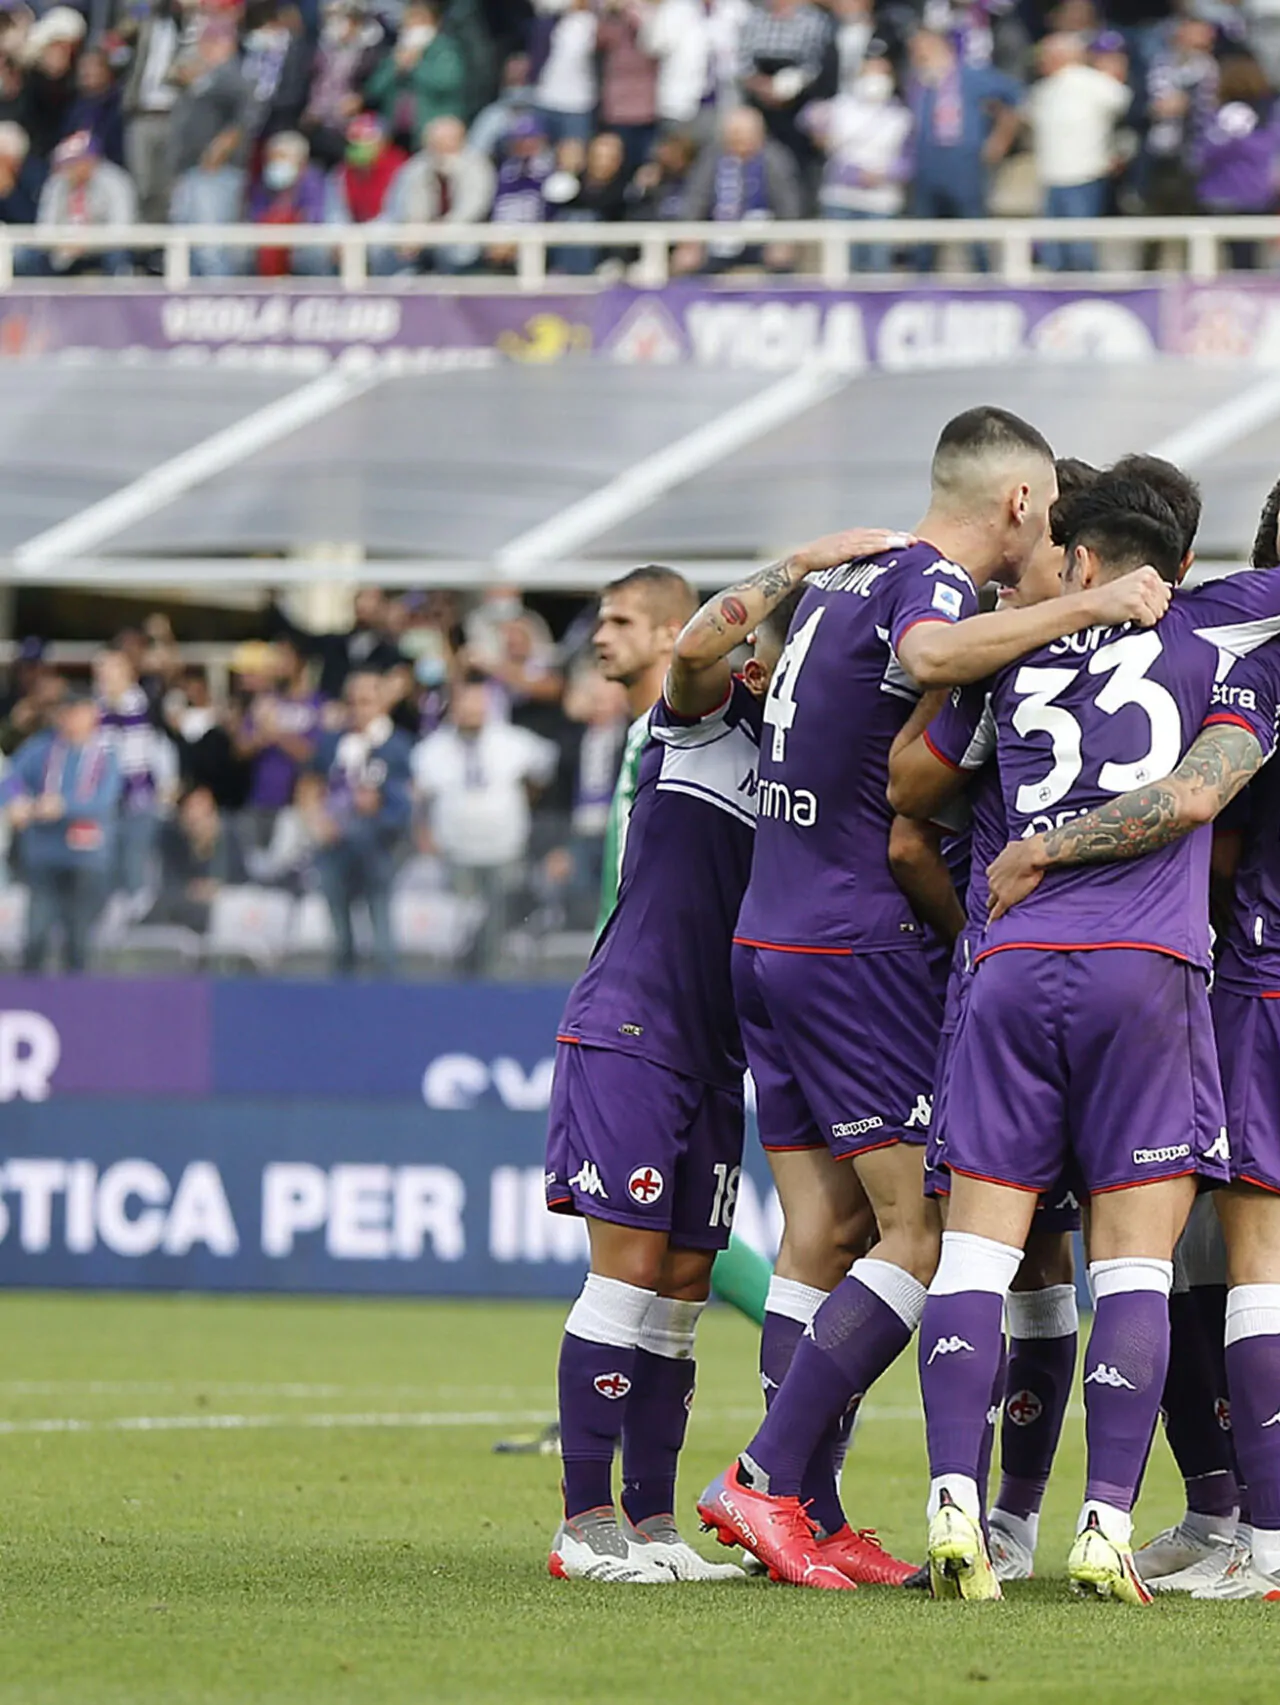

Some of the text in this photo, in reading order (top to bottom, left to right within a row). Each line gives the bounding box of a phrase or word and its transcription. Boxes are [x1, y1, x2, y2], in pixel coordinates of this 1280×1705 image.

[763, 606, 826, 762] 4
[1010, 628, 1182, 815] 33
[831, 1116, 883, 1138] Kappa
[1133, 1144, 1191, 1164] Kappa
[0, 1155, 240, 1258] TICA
[260, 1162, 467, 1262] PER
